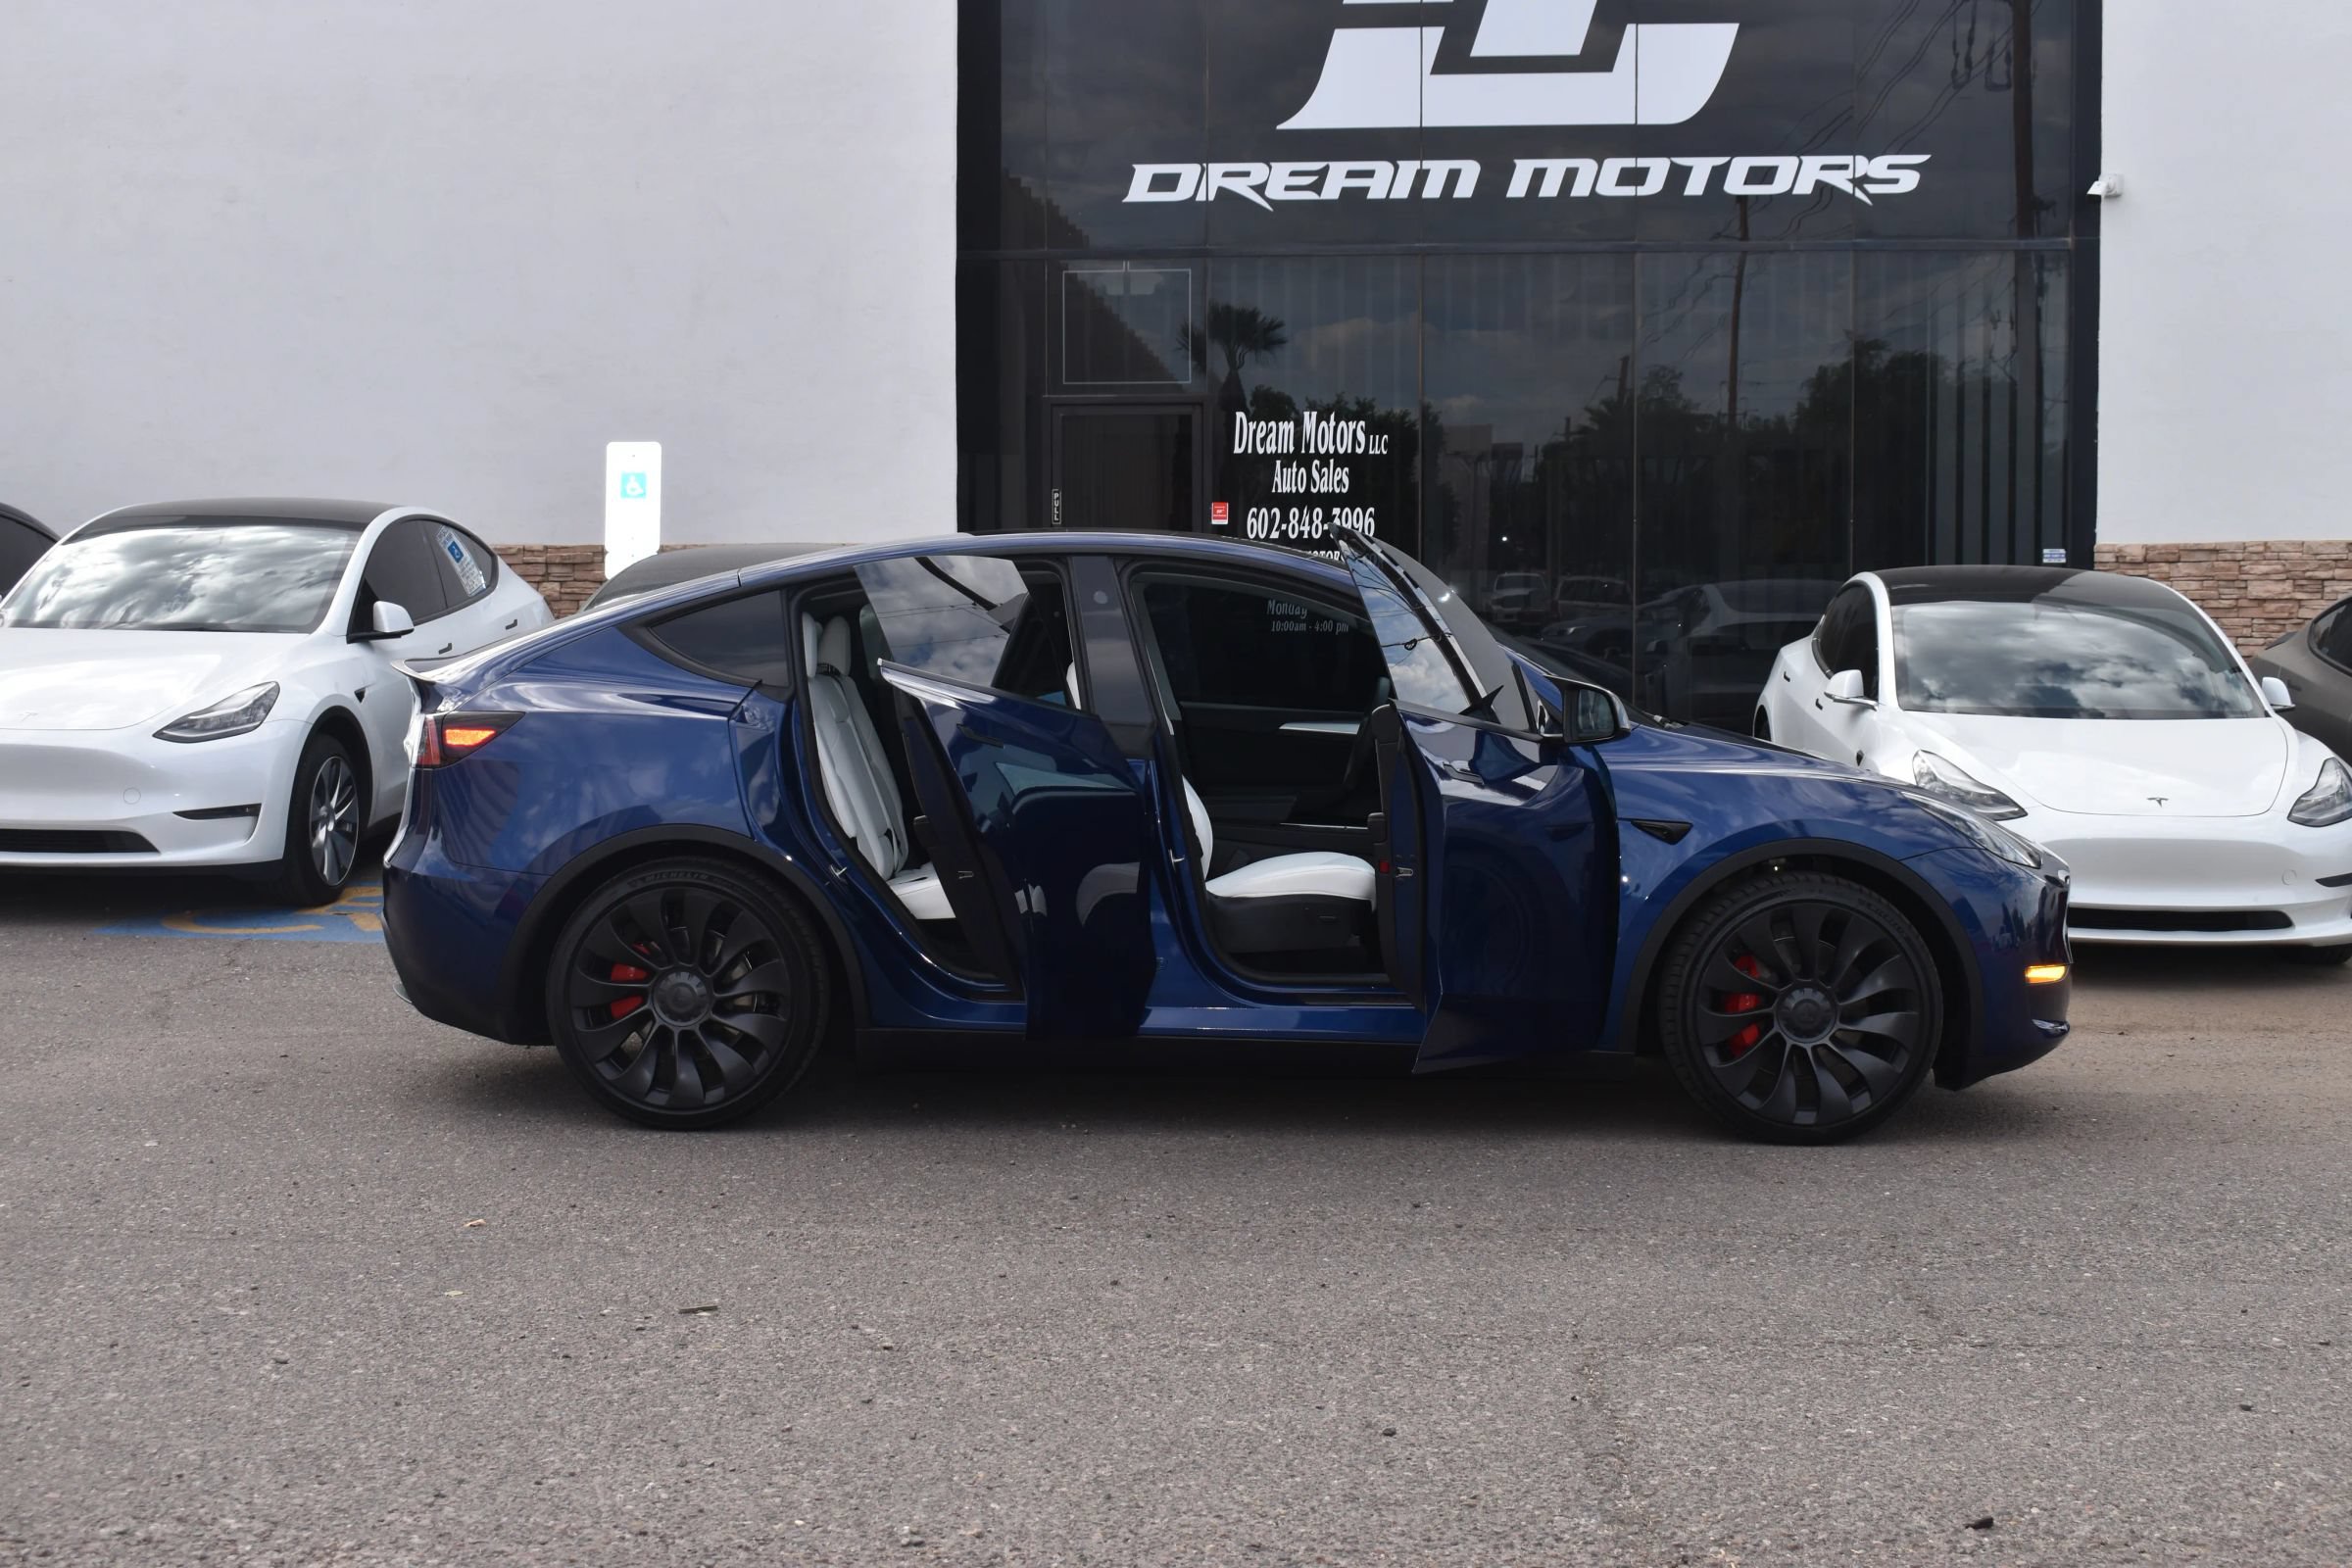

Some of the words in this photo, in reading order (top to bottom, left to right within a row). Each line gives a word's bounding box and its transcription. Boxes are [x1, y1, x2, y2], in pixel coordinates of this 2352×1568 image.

[1122, 160, 1482, 212] DREAM
[1505, 154, 1932, 206] MOTORS
[1233, 411, 1295, 455] Dream
[1300, 411, 1366, 455] Motors
[1368, 434, 1389, 455] LLC
[1271, 459, 1307, 494] Auto
[1310, 458, 1349, 494] Sales
[1271, 619, 1306, 632] 10:00am
[1314, 619, 1334, 632] 4:00
[1335, 621, 1349, 635] pm
